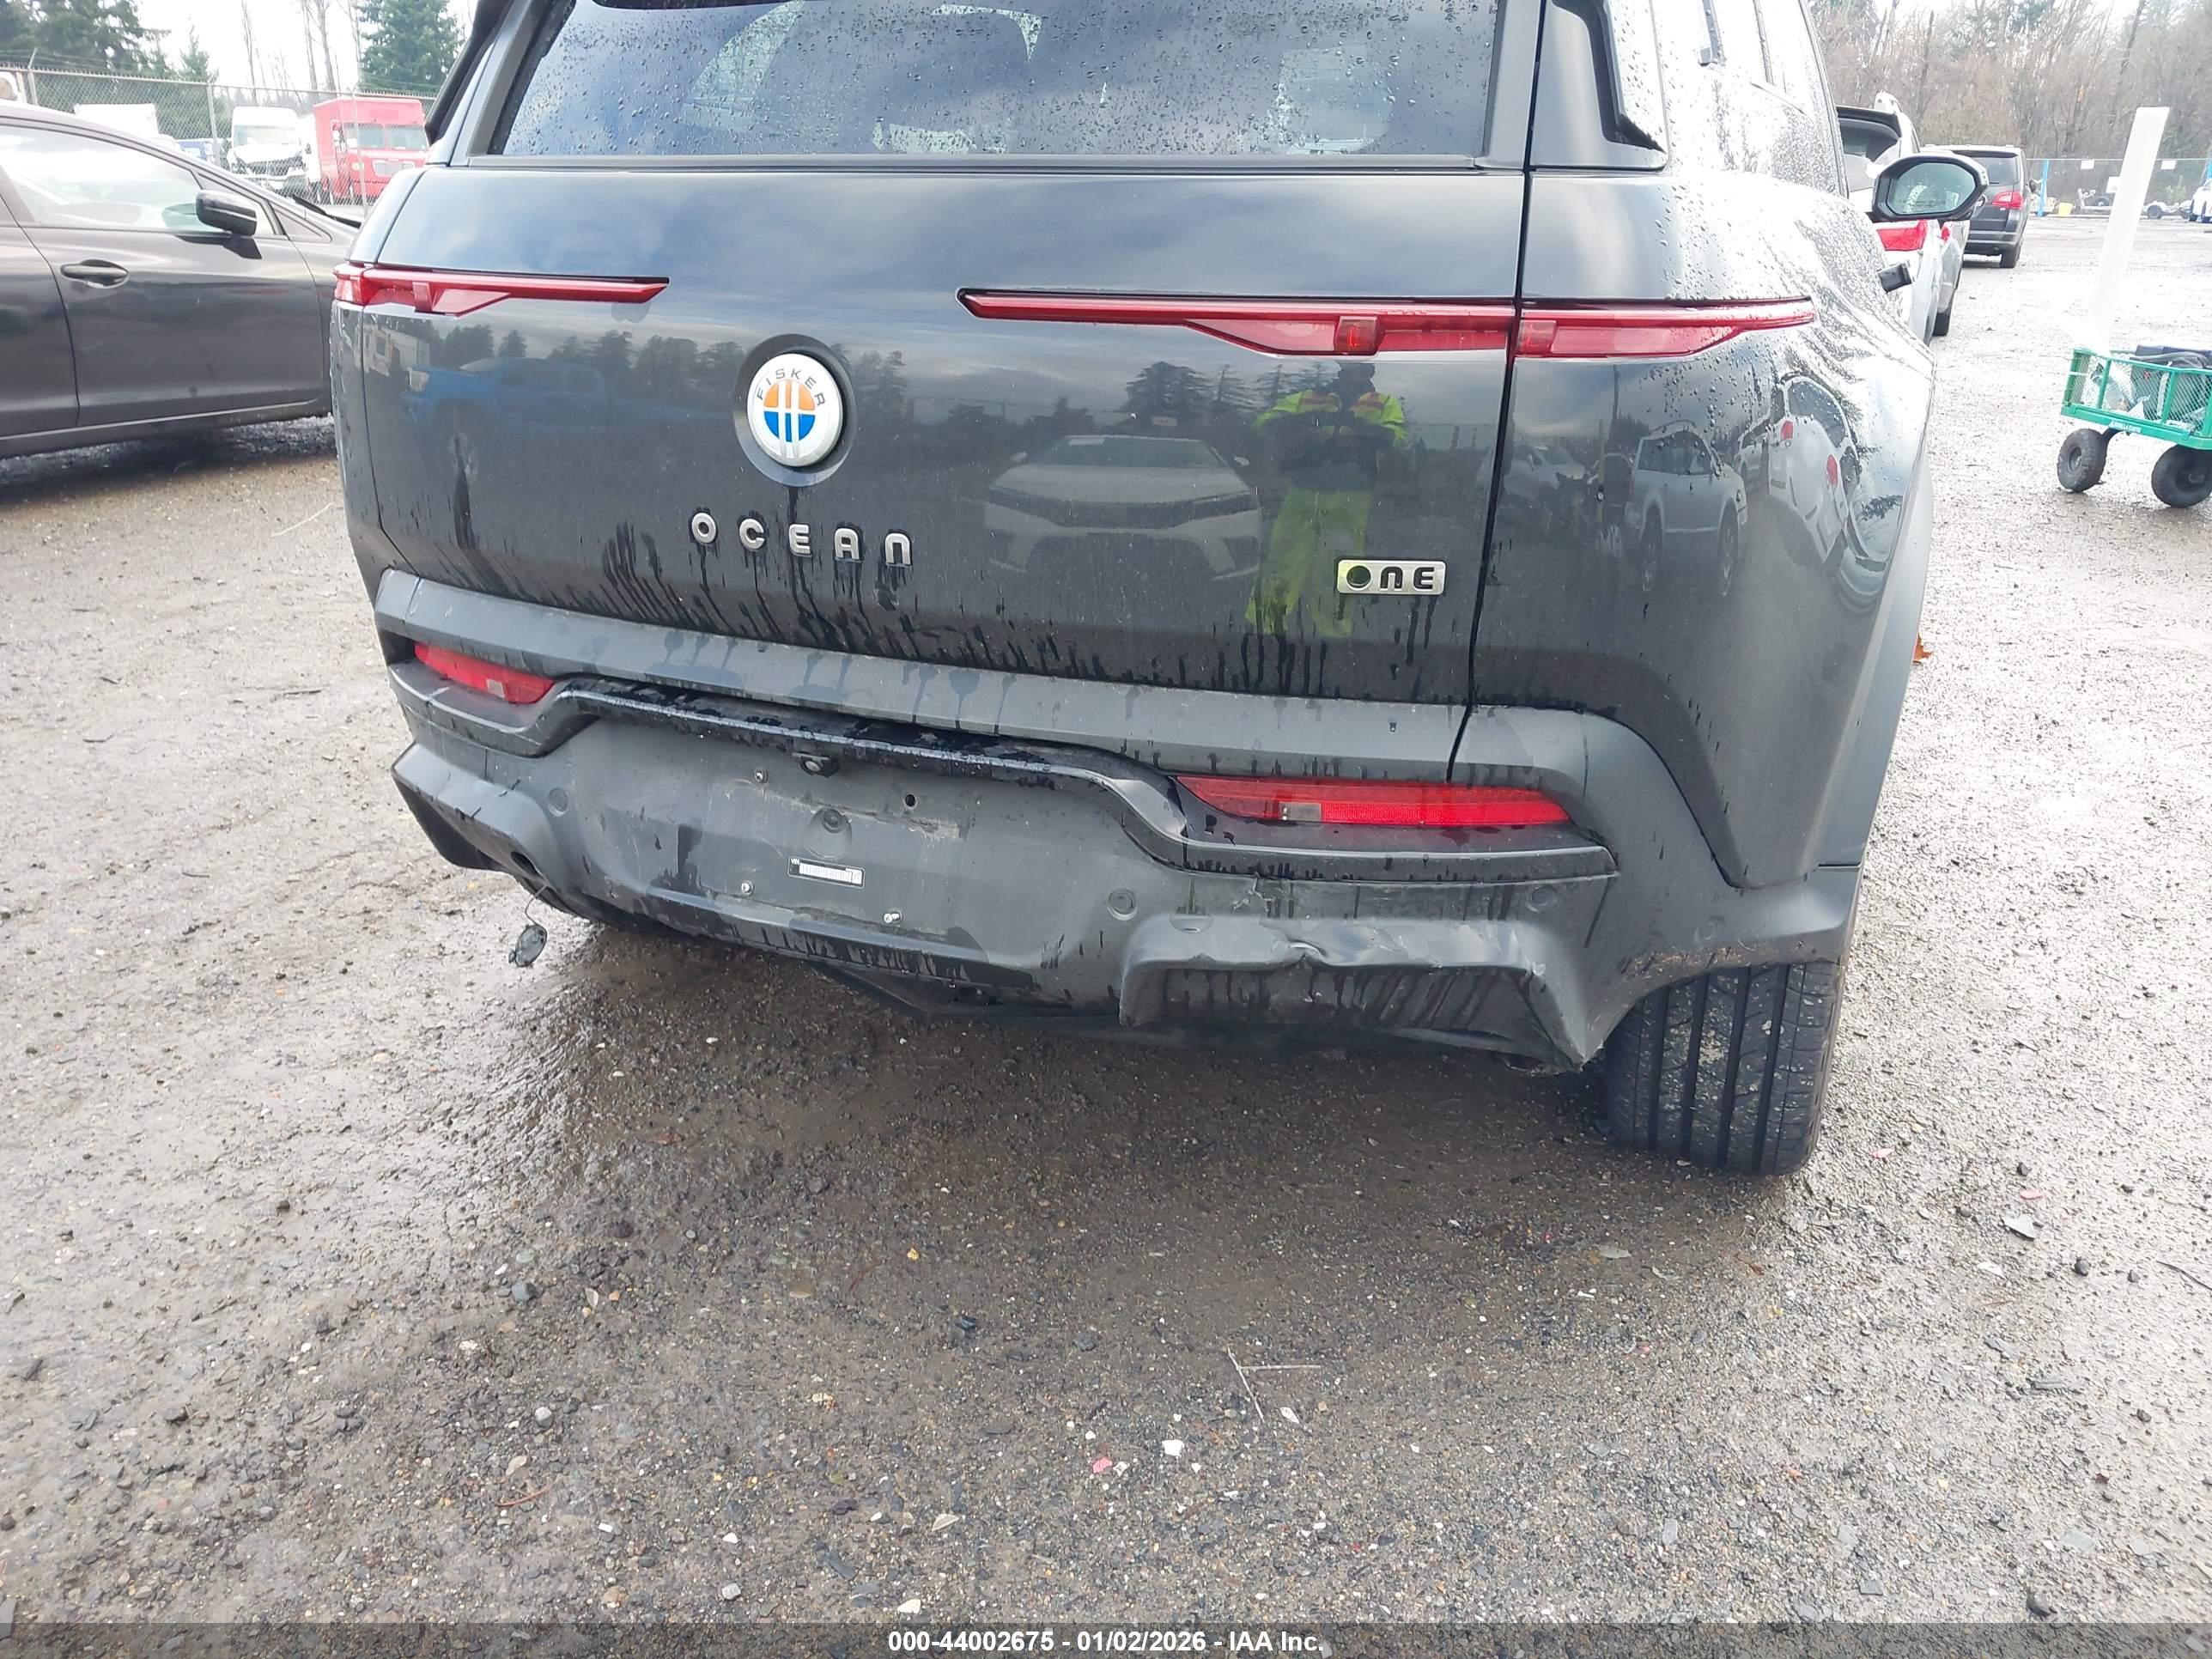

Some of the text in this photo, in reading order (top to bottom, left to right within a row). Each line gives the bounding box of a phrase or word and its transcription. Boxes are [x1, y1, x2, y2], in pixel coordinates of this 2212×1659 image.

[757, 368, 825, 406] FISKER
[690, 511, 913, 566] OCEAN
[1346, 565, 1435, 590] ONE
